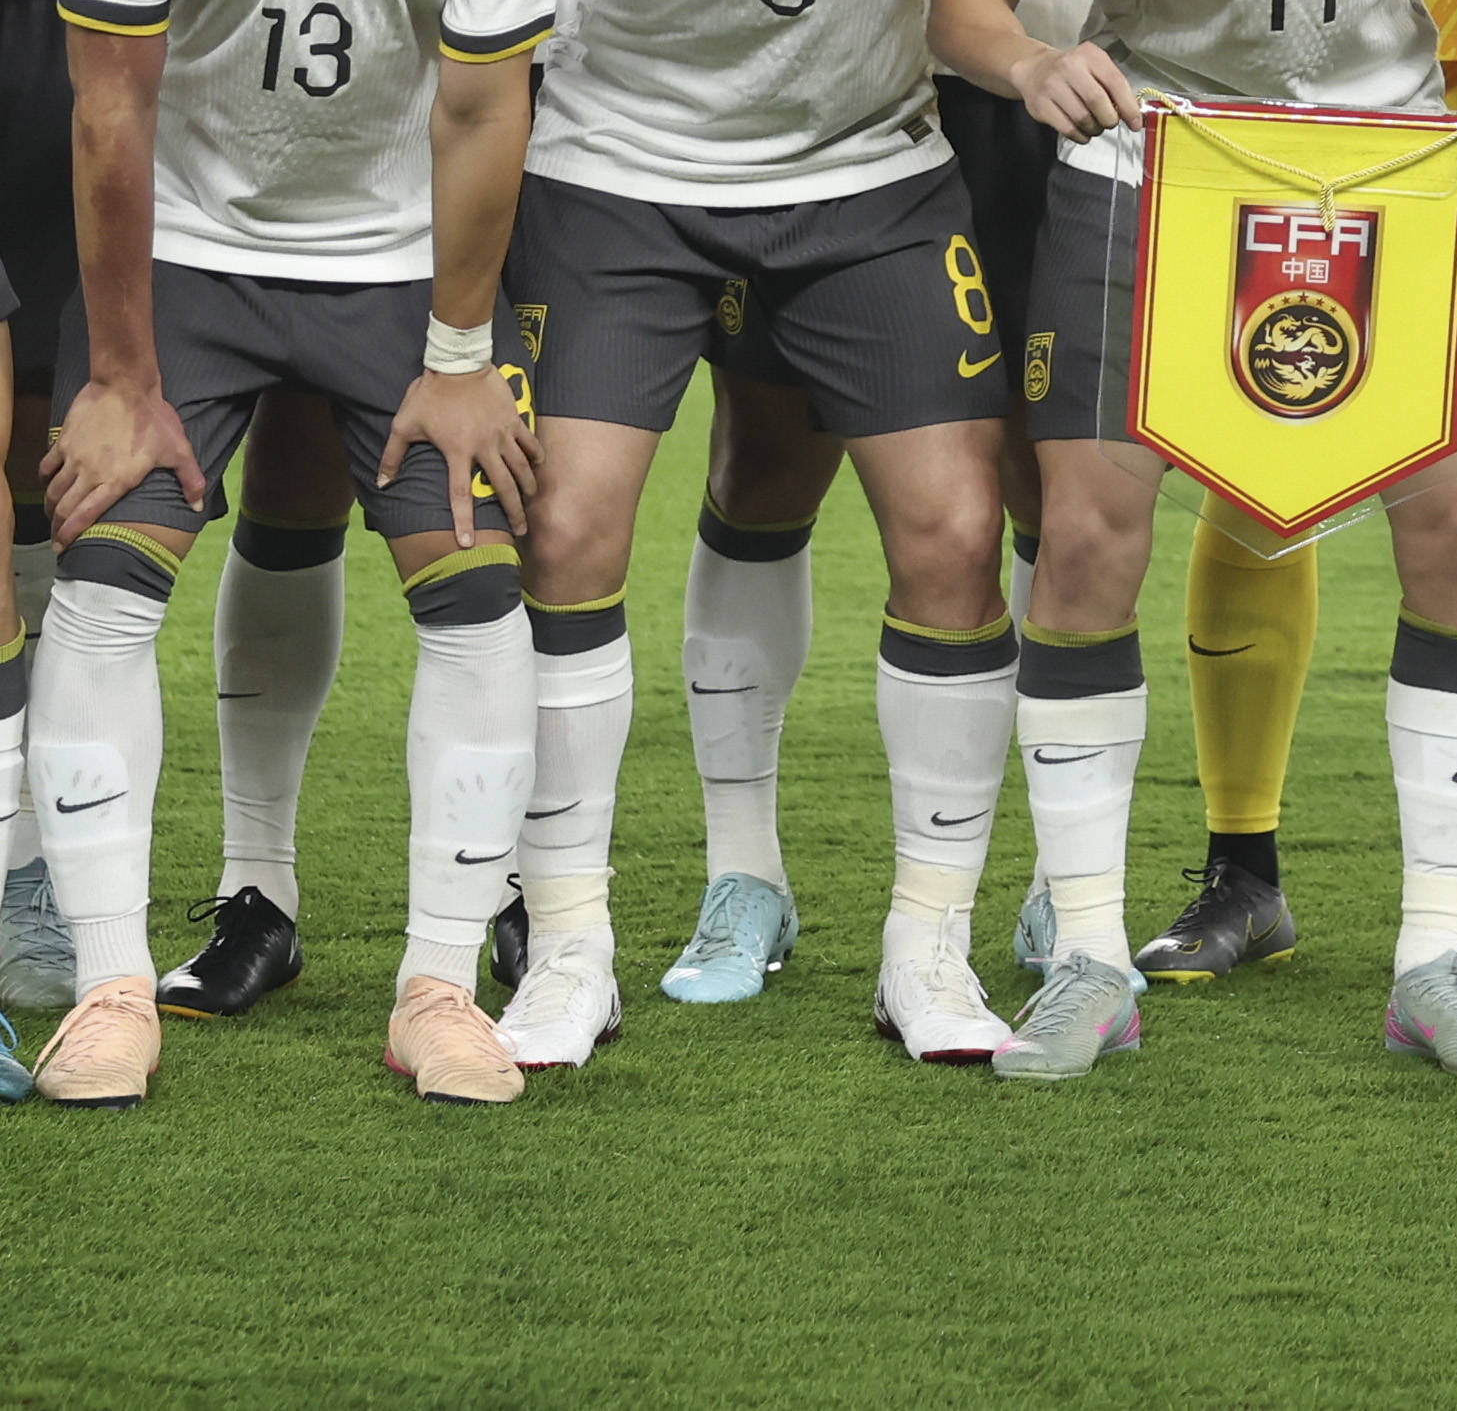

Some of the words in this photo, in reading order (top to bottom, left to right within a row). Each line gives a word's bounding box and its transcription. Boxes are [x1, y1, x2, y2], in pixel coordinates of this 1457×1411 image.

[261, 2, 353, 98] 13
[1245, 213, 1370, 257] CFA
[945, 234, 993, 335] 8
[1281, 257, 1330, 284] 中国
